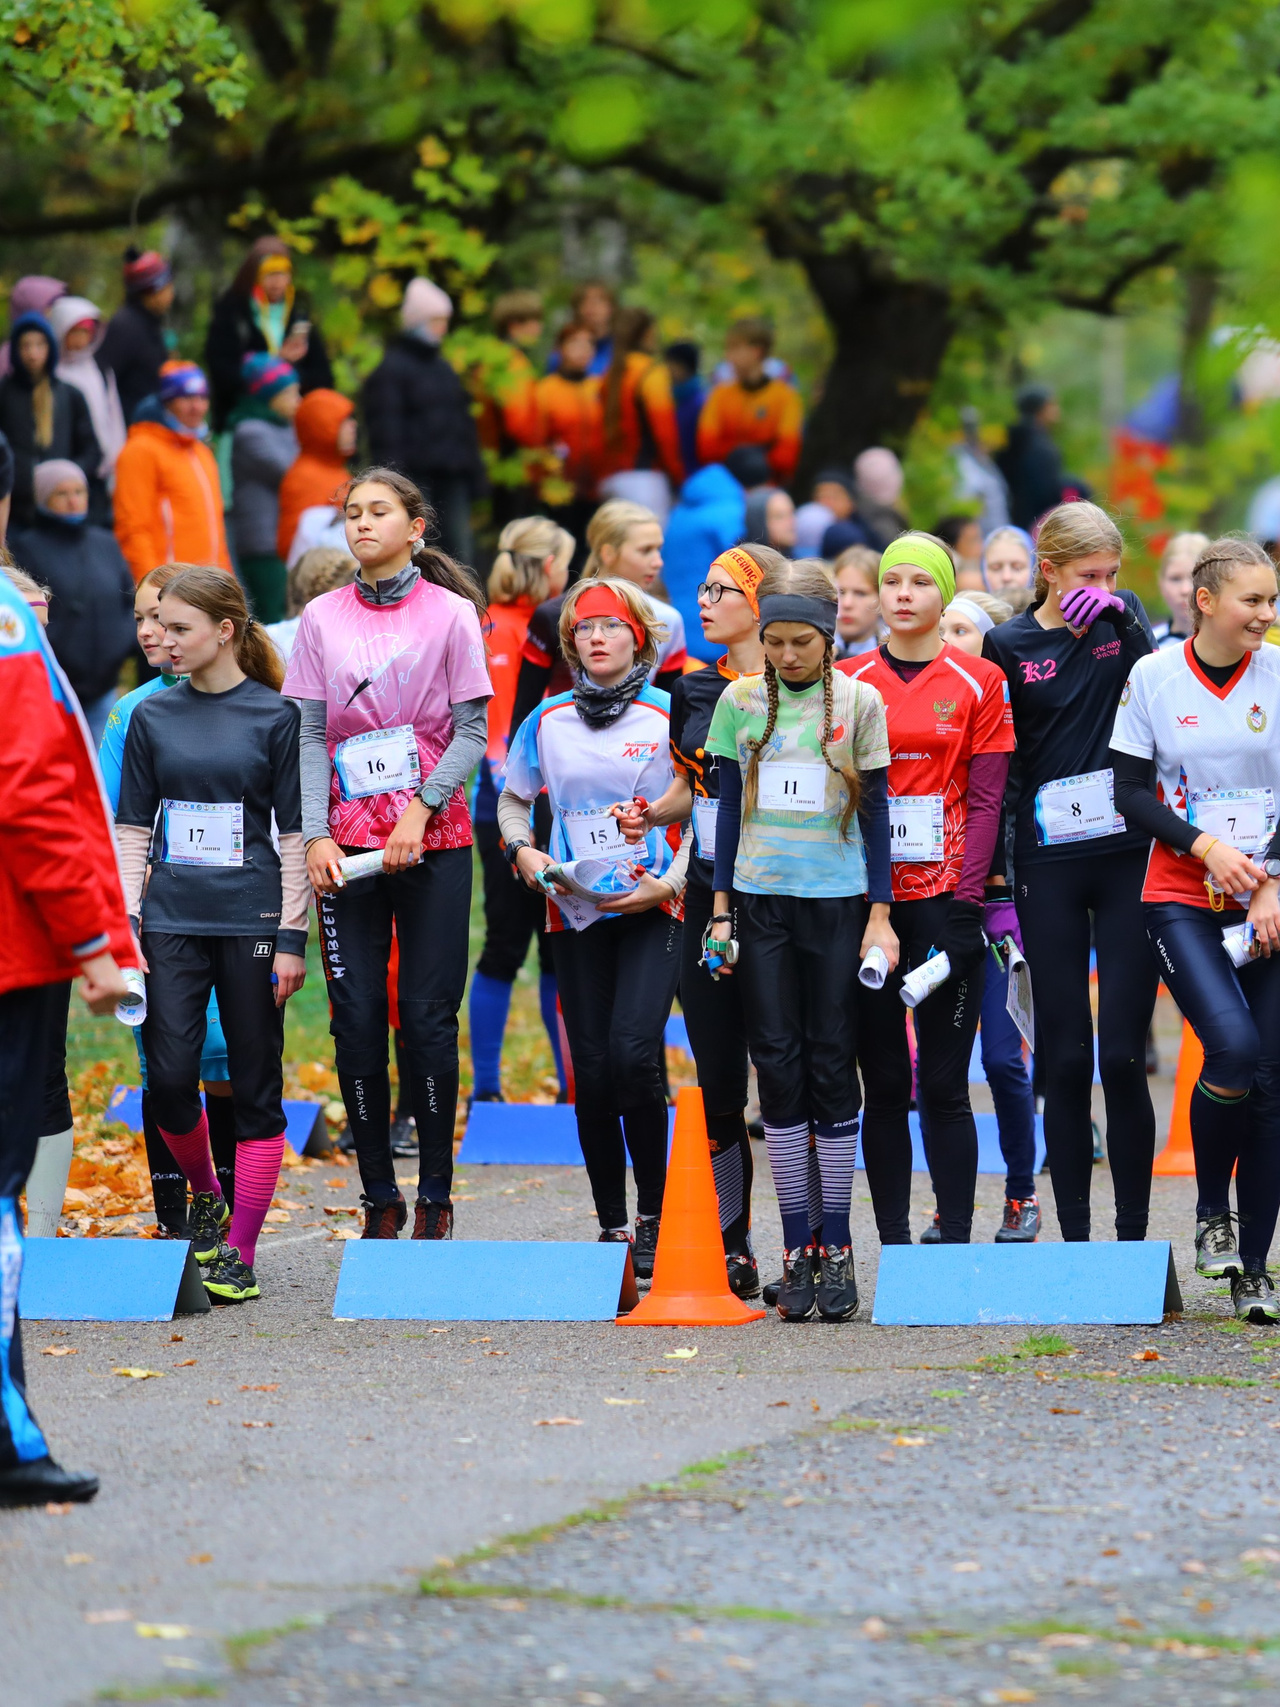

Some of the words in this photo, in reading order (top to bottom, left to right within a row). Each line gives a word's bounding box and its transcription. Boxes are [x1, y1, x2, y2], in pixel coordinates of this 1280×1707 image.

[367, 757, 385, 774] 16
[784, 780, 797, 794] 11
[1071, 802, 1081, 817] 8
[890, 824, 907, 838] 10
[1227, 818, 1236, 832] 7
[189, 828, 204, 843] 17
[590, 829, 608, 844] 15
